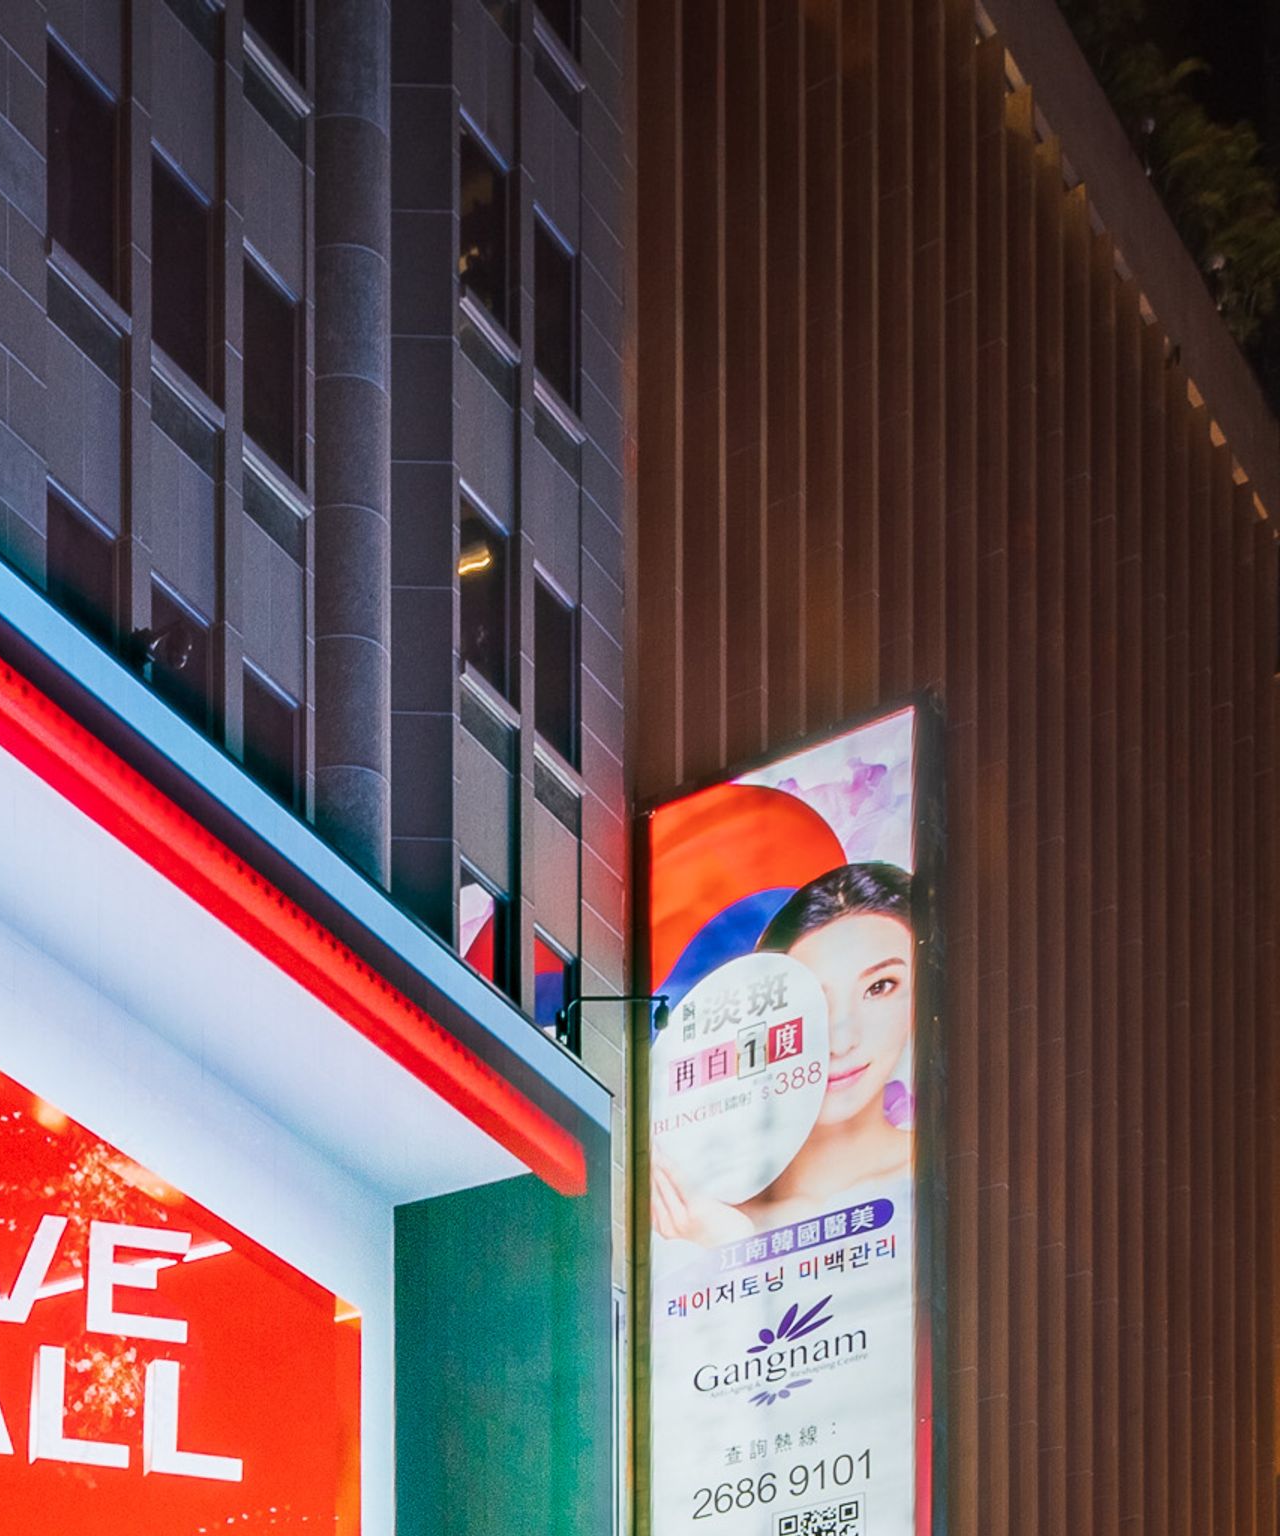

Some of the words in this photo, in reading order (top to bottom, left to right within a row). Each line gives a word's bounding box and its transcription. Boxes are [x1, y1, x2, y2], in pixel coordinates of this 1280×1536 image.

[720, 1205, 874, 1271] 江南韓國醫美
[667, 1266, 784, 1317] 레이저토닝
[799, 1235, 896, 1280] 미백관리
[693, 1329, 867, 1392] Gangnam
[692, 1472, 777, 1519] 2686
[789, 1449, 872, 1496] 9101
